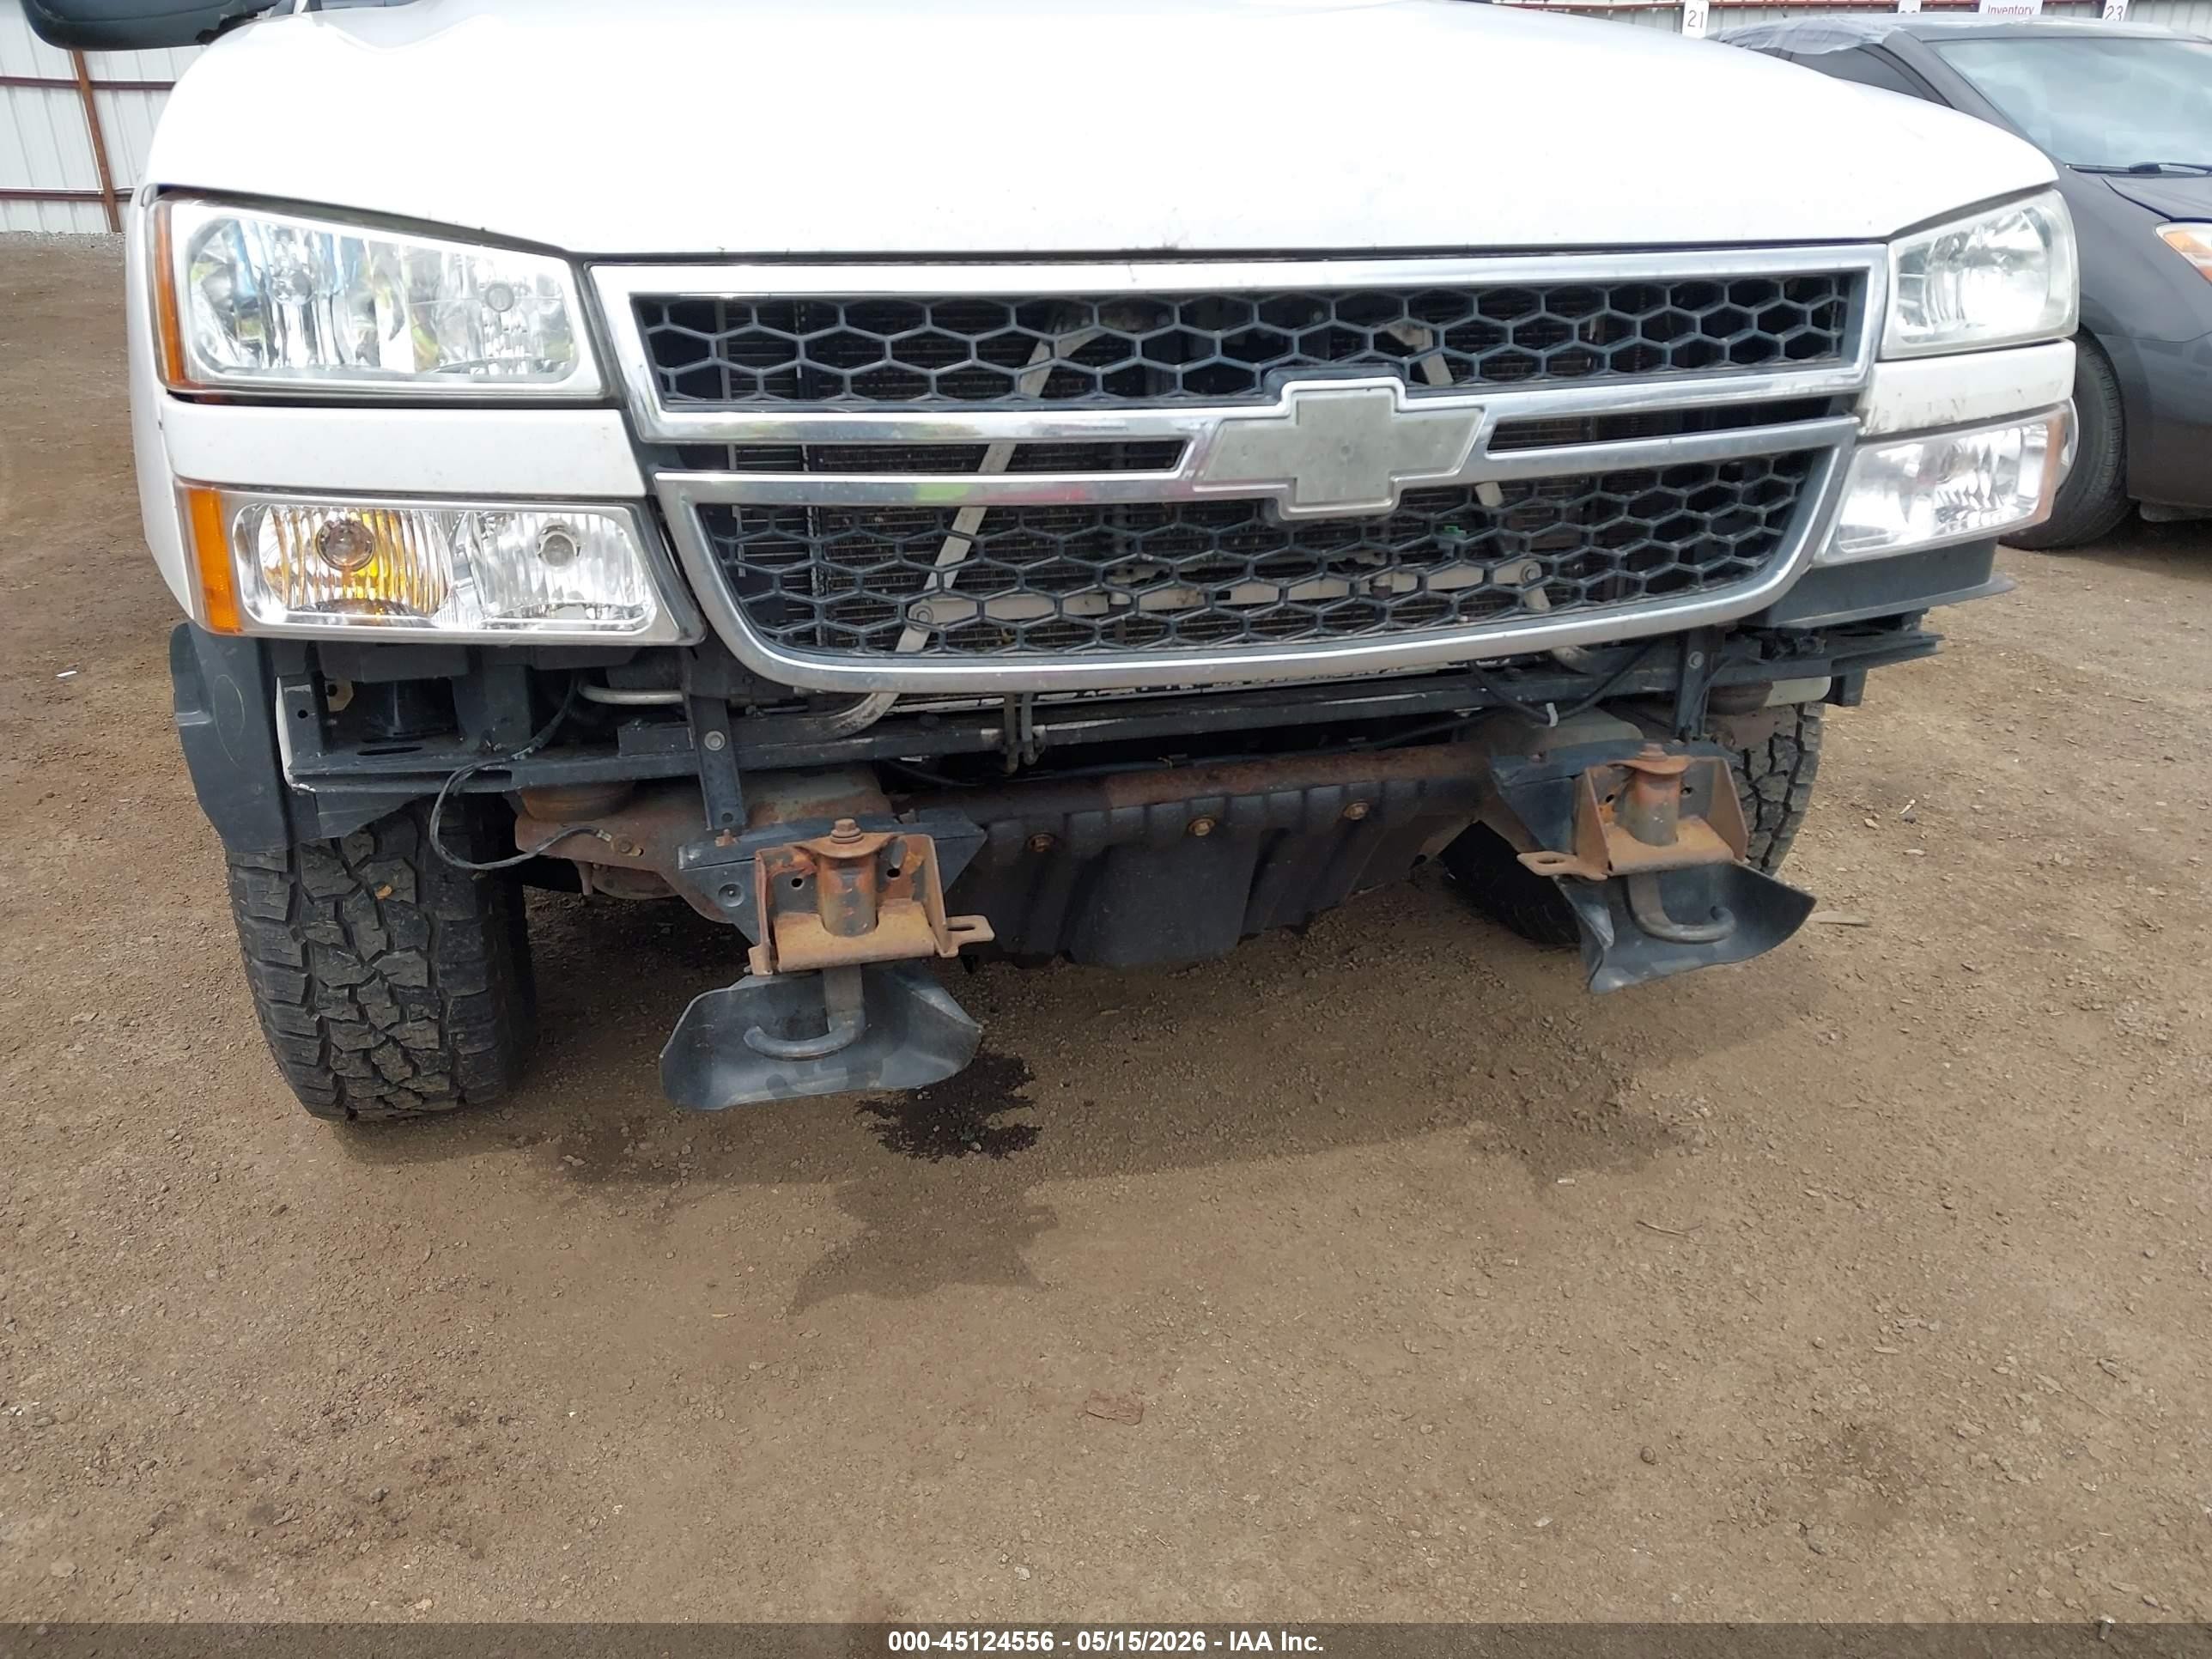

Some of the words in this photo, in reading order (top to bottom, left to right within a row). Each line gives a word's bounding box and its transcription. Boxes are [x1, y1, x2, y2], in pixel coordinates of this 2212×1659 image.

[1987, 4, 2034, 15] Inventory
[2104, 4, 2124, 21] 23
[1687, 9, 1705, 28] 21
